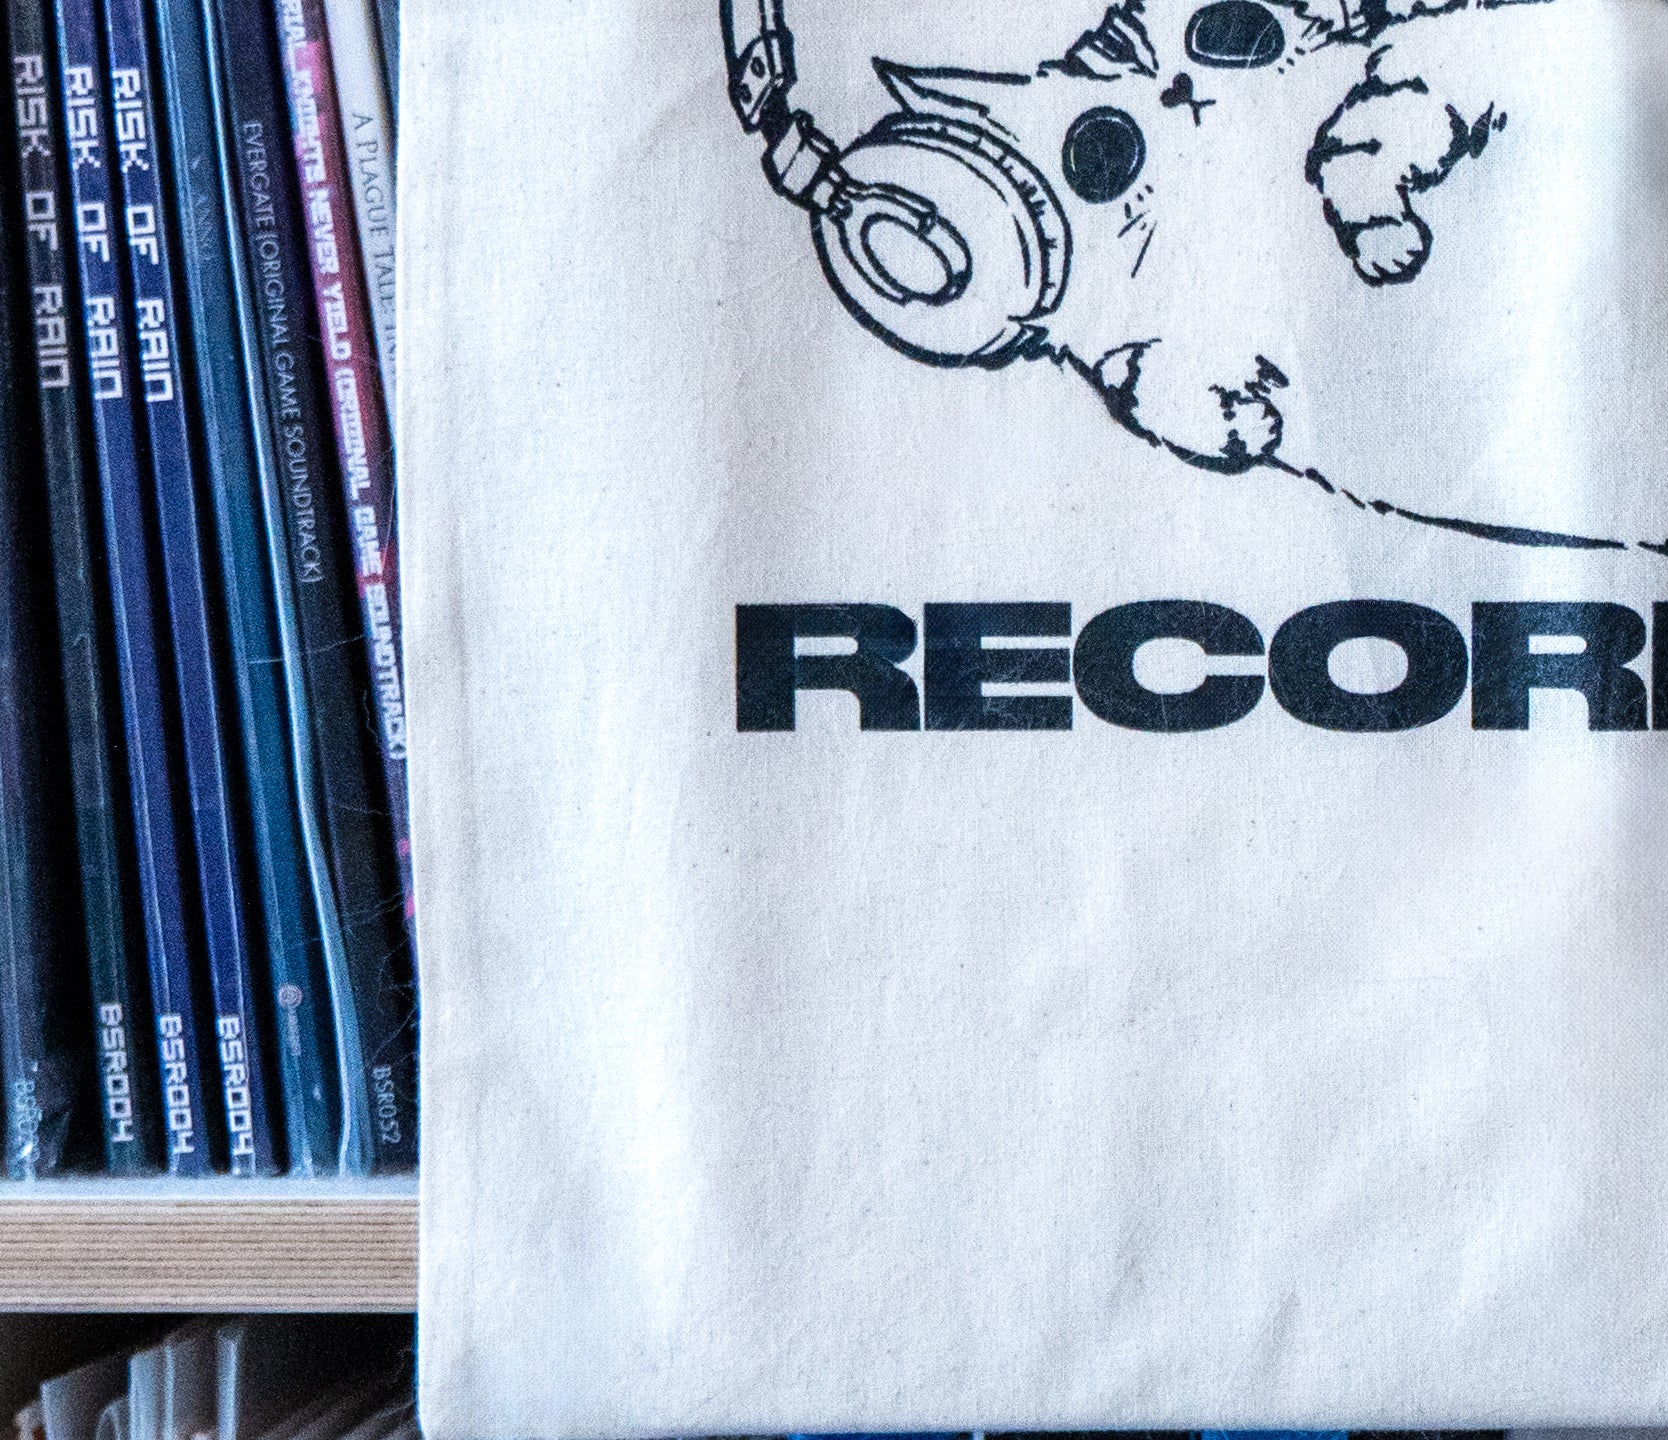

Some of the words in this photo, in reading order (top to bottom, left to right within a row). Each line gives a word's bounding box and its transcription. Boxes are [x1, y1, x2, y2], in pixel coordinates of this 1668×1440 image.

[14, 54, 51, 160] RISK
[64, 65, 101, 170] RISK
[112, 68, 150, 172] RISK
[25, 190, 58, 251] OF
[243, 120, 276, 227] EVERGATE
[76, 201, 110, 262] OF
[125, 204, 159, 265] OF
[308, 189, 340, 274] NEVER
[33, 283, 70, 389] RAIN
[255, 232, 289, 349] (ORIGINAL
[322, 282, 351, 360] YIELD
[85, 295, 123, 401] RAIN
[135, 298, 173, 403] RAIN
[274, 352, 302, 419] GAME
[334, 368, 370, 500] (ORIGINAL
[285, 425, 323, 584] SOUNDTRACK)
[354, 506, 383, 576] GAME
[363, 583, 407, 760] SOUNDTRACK)
[99, 1003, 134, 1143] BSR004
[157, 1013, 195, 1155] BSR004
[216, 1015, 253, 1156] BSR004
[372, 1066, 400, 1145] BSR052
